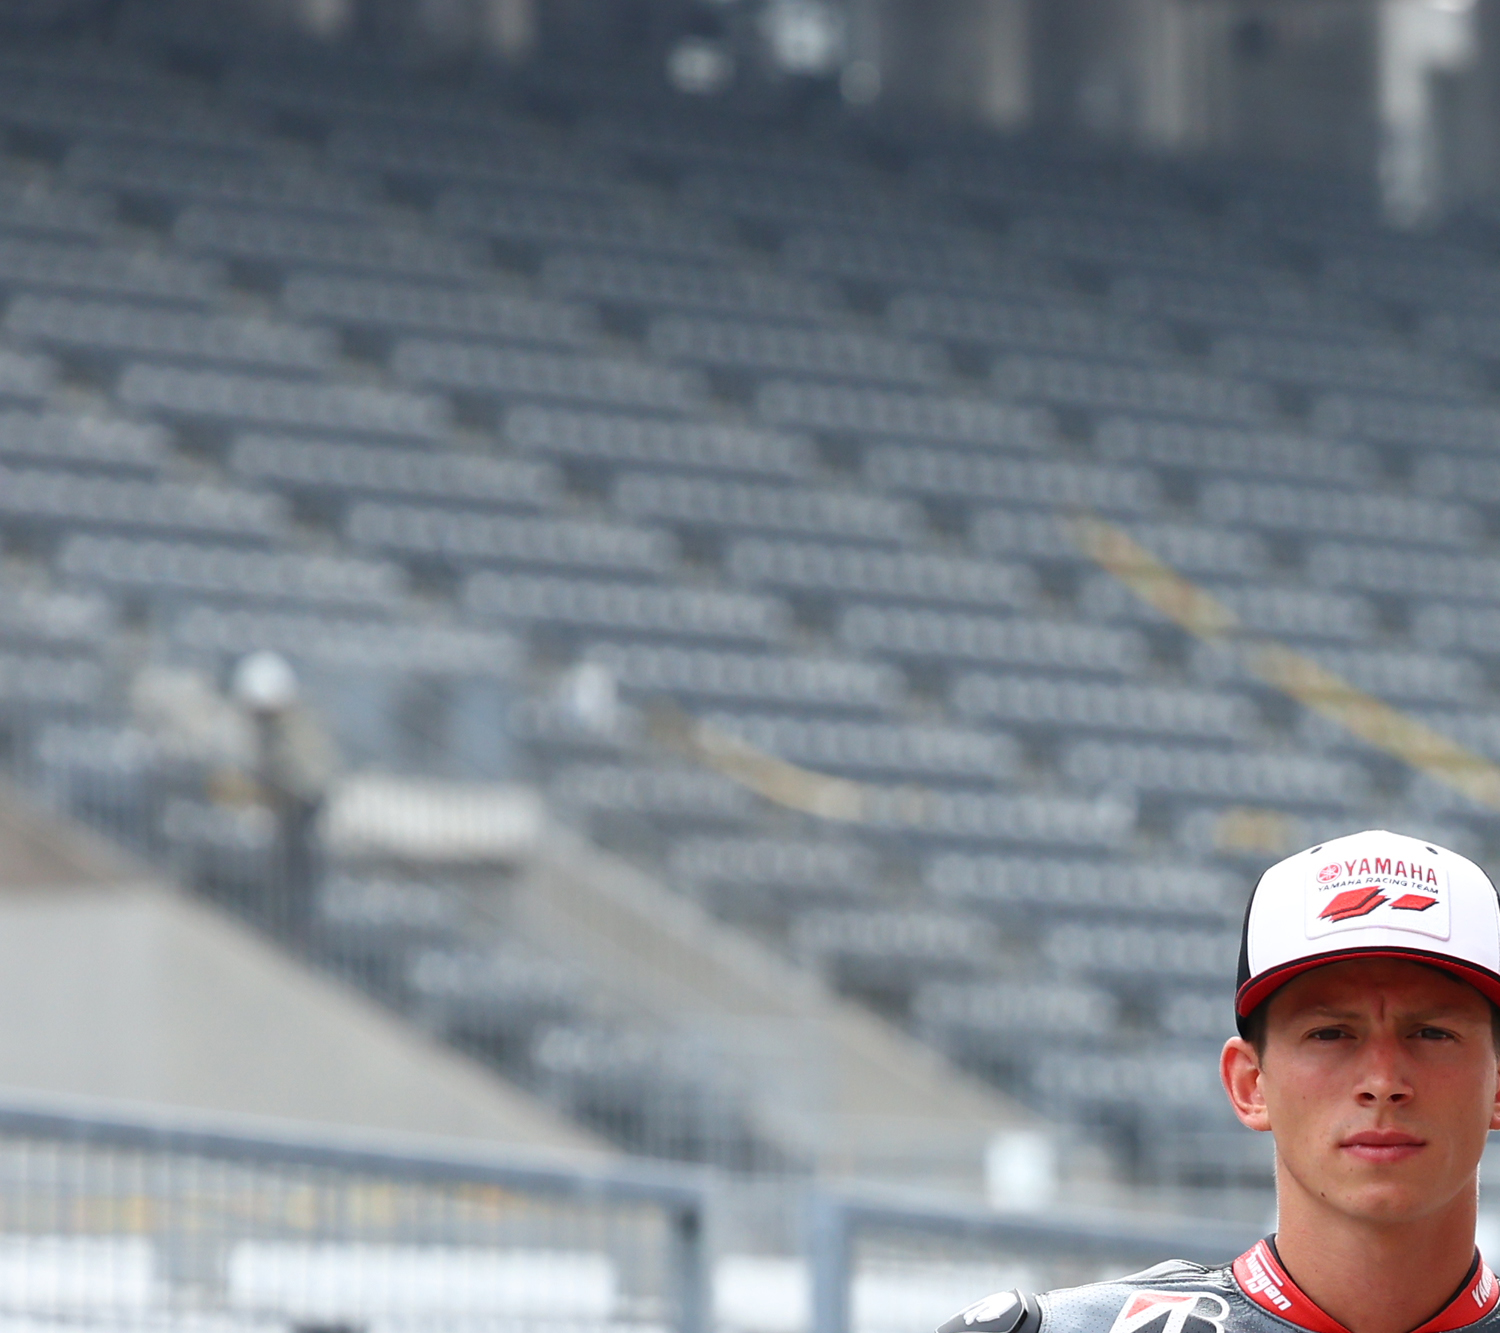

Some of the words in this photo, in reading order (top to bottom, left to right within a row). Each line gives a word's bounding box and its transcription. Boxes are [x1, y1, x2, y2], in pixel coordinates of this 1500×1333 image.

[1344, 857, 1438, 887] YAMAHA
[1317, 877, 1363, 893] YAMAHA
[1365, 876, 1409, 888] RACING
[1410, 881, 1440, 895] TEAM
